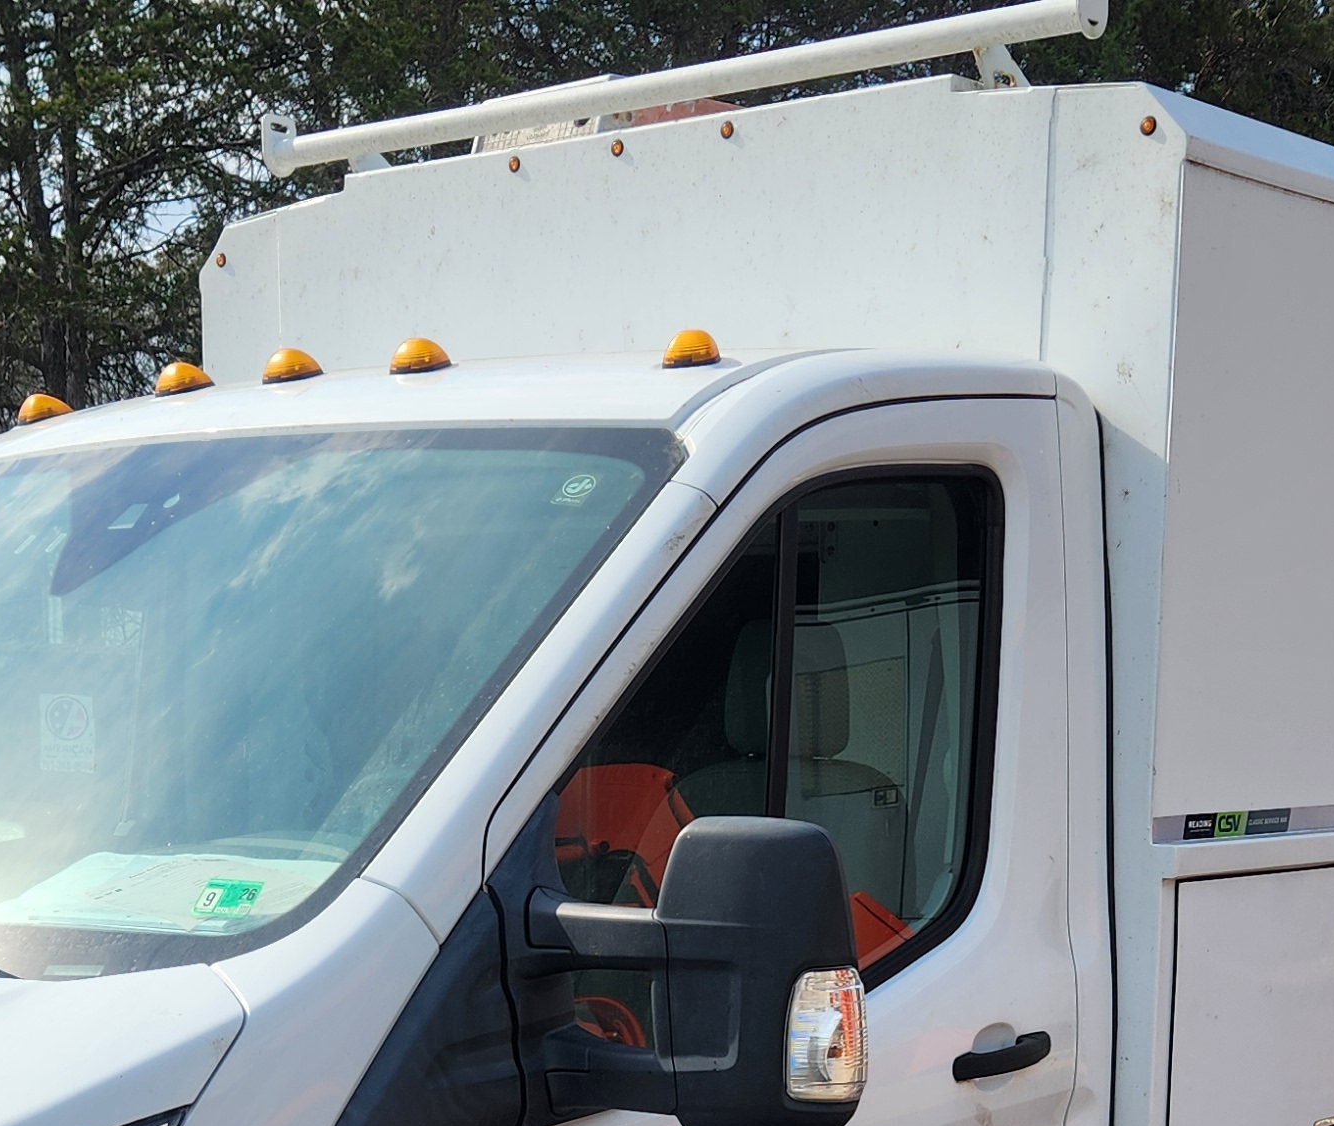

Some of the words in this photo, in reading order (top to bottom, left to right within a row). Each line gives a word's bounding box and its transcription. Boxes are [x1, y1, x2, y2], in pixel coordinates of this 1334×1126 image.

[1188, 819, 1212, 829] READING
[1218, 814, 1242, 833] CSV
[203, 891, 217, 907] 9
[238, 887, 258, 901] 26
